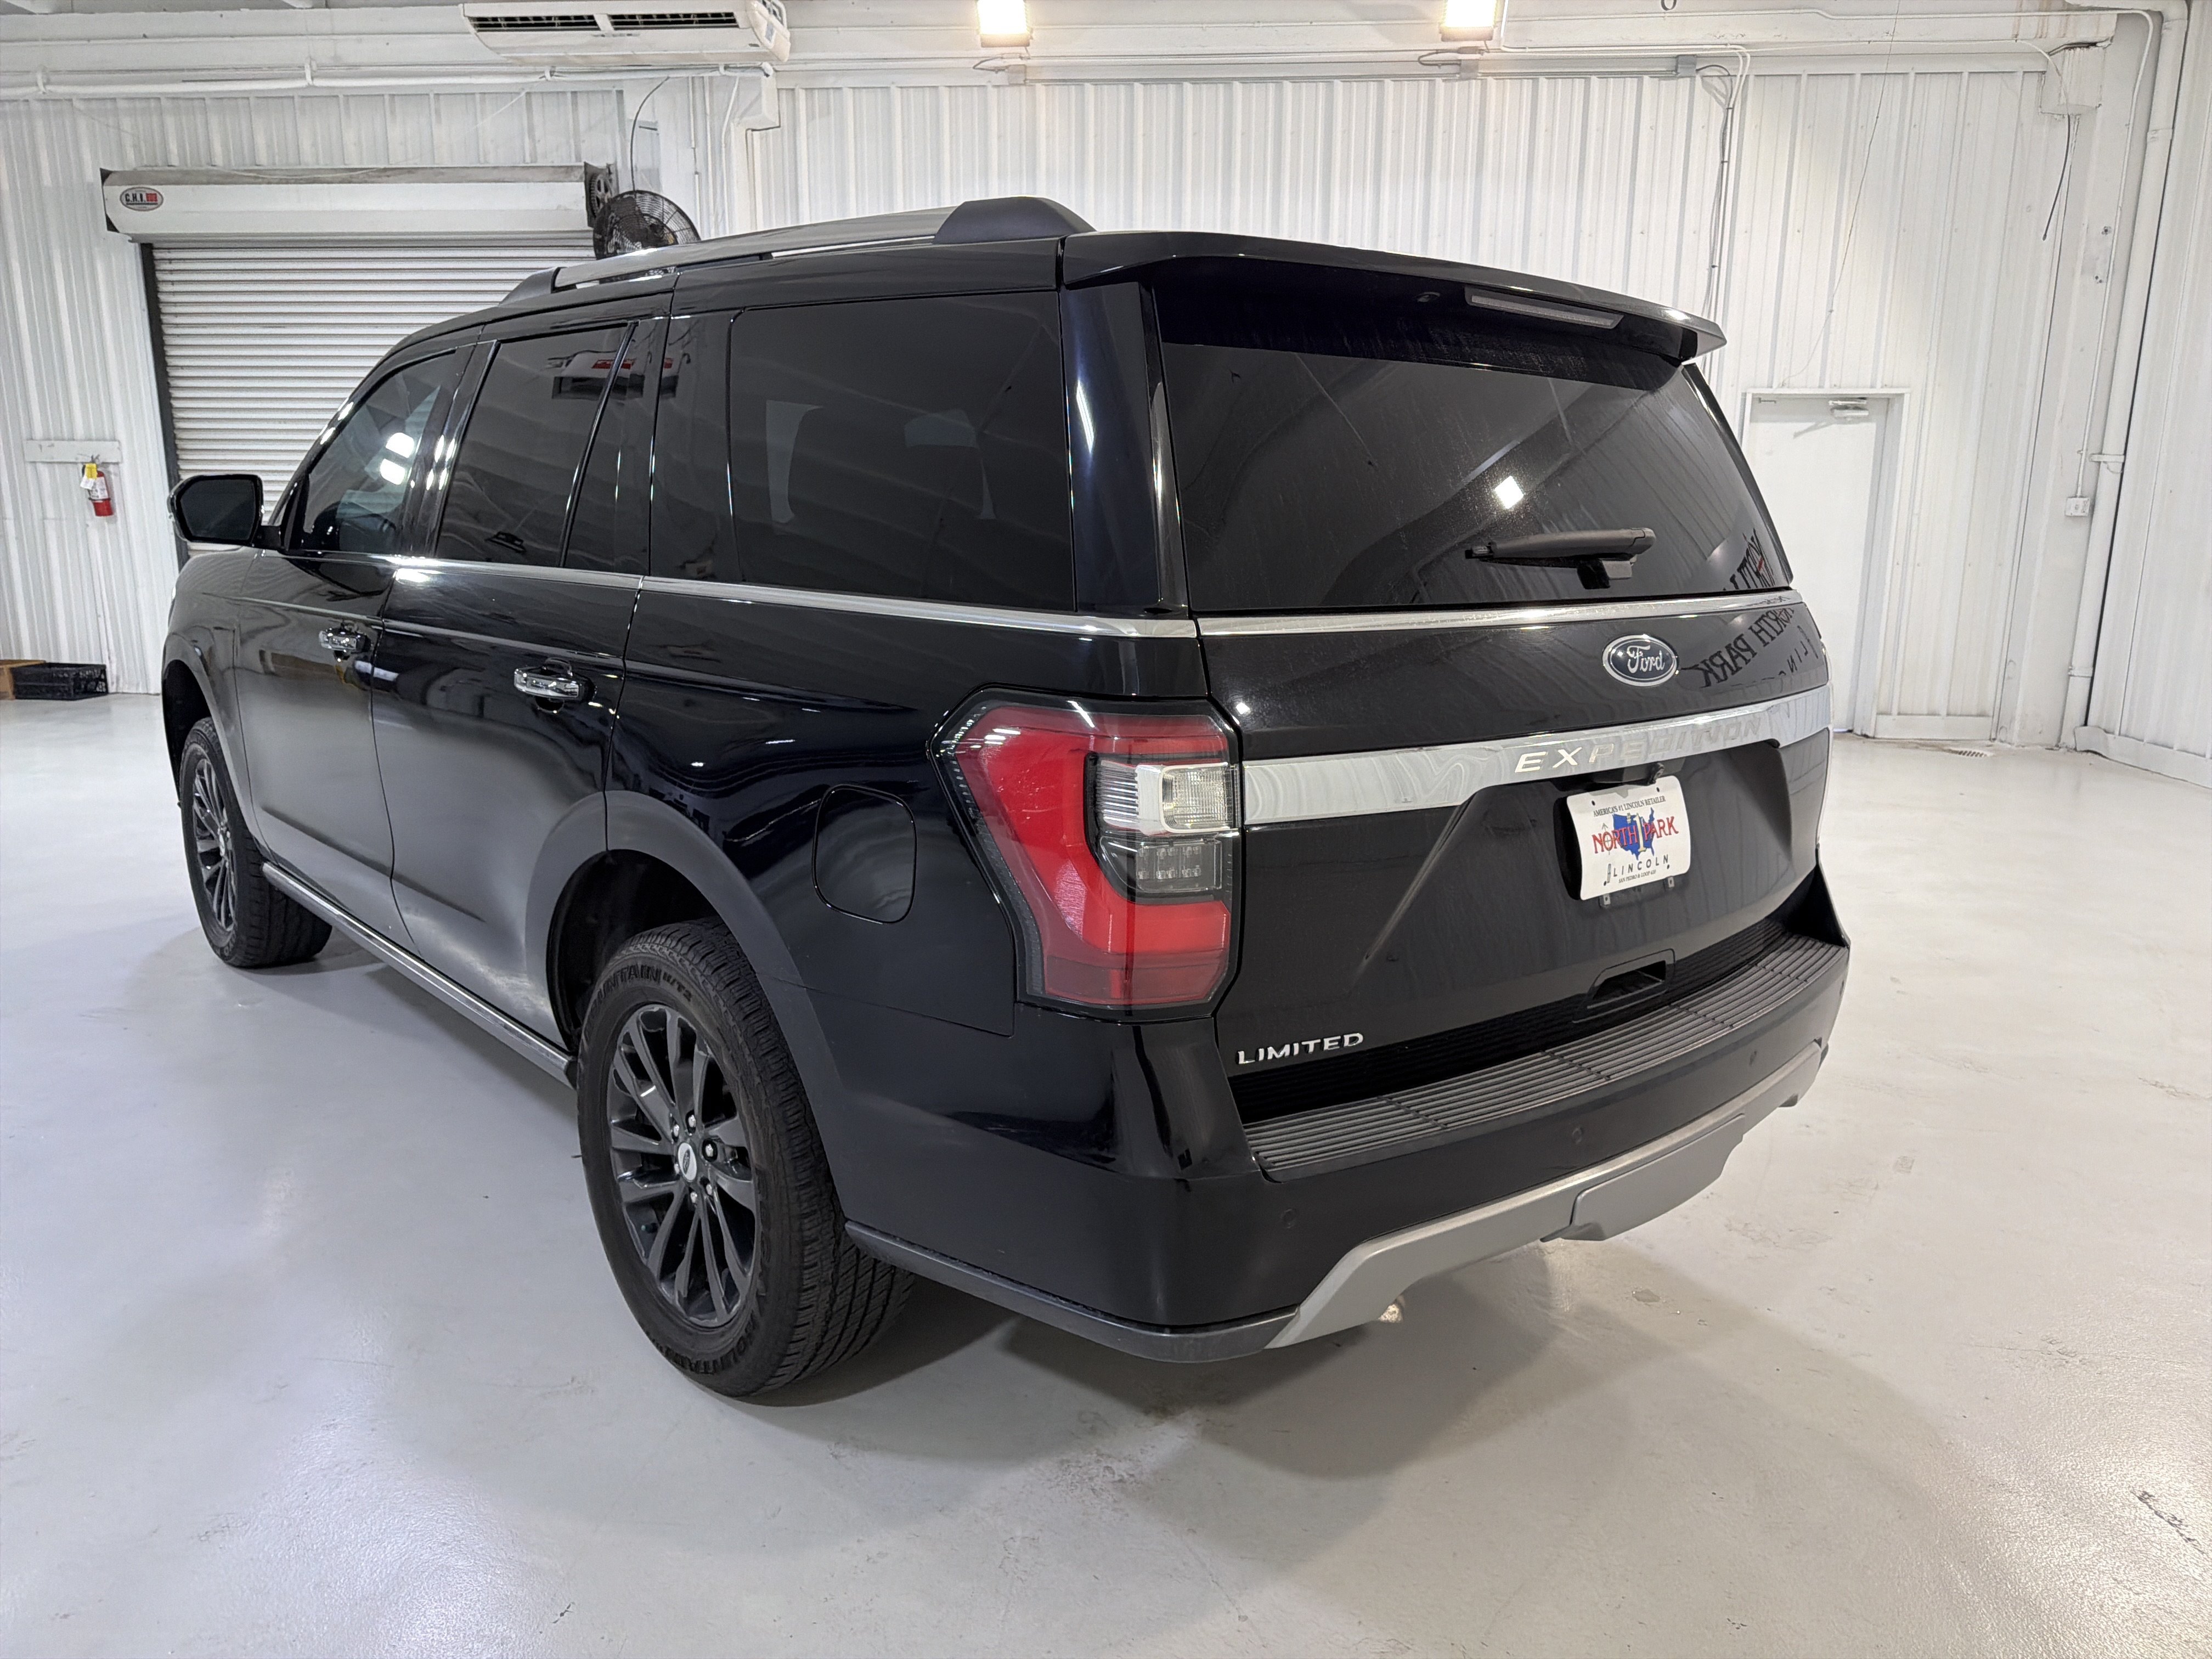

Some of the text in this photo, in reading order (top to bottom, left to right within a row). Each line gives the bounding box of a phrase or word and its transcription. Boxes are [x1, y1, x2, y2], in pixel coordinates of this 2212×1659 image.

[1627, 645, 1665, 673] Ford
[1514, 716, 1762, 773] EXPEDITION
[1593, 806, 1618, 817] AMERICA'S
[1624, 800, 1645, 811] LINCOLN
[1645, 795, 1666, 806] RETAILER
[1592, 816, 1679, 854] NORTH PARK
[1613, 854, 1668, 877] LINCOLN
[1237, 1032, 1364, 1065] LIMITED
